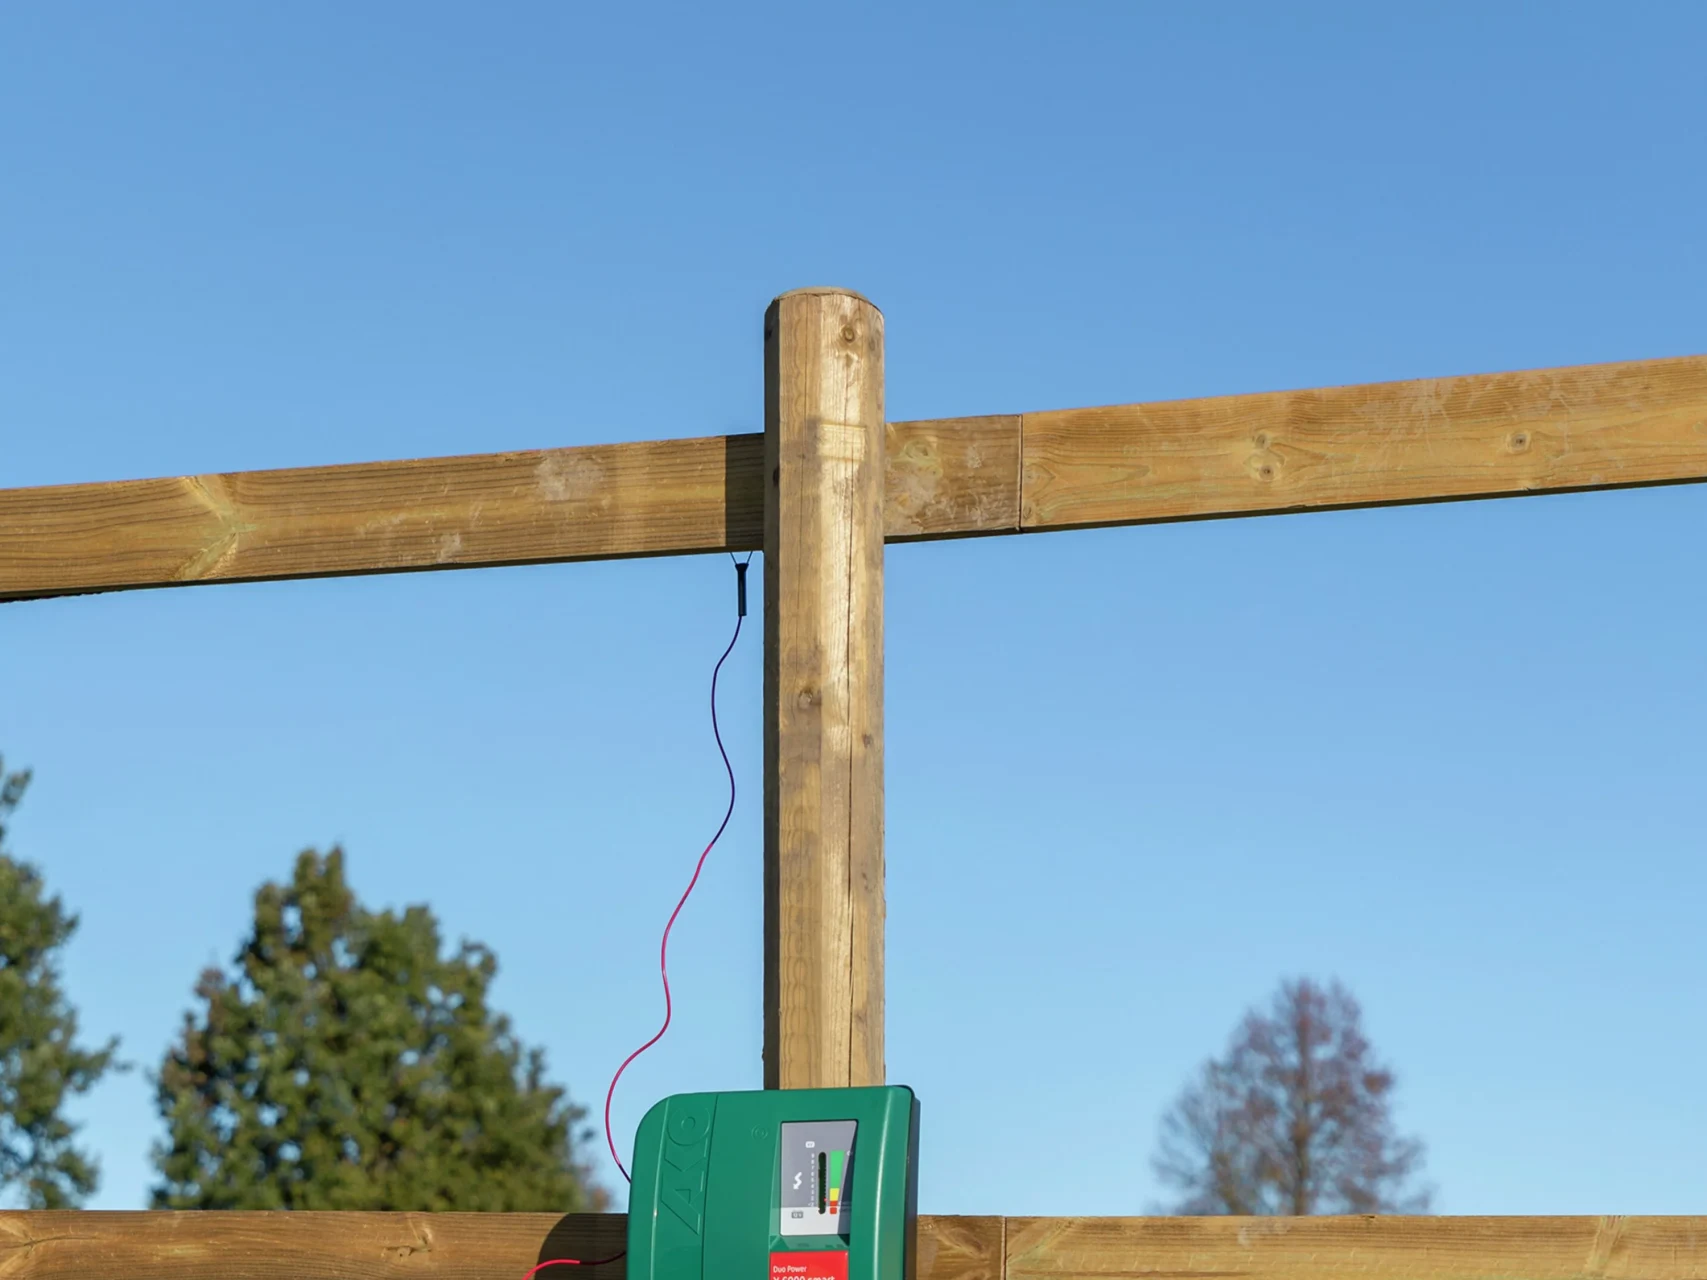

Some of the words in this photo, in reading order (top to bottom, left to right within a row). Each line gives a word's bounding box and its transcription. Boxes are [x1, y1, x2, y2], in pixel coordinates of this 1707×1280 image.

[661, 1105, 711, 1236] AKO
[773, 1265, 786, 1273] Duo
[787, 1264, 807, 1273] Power
